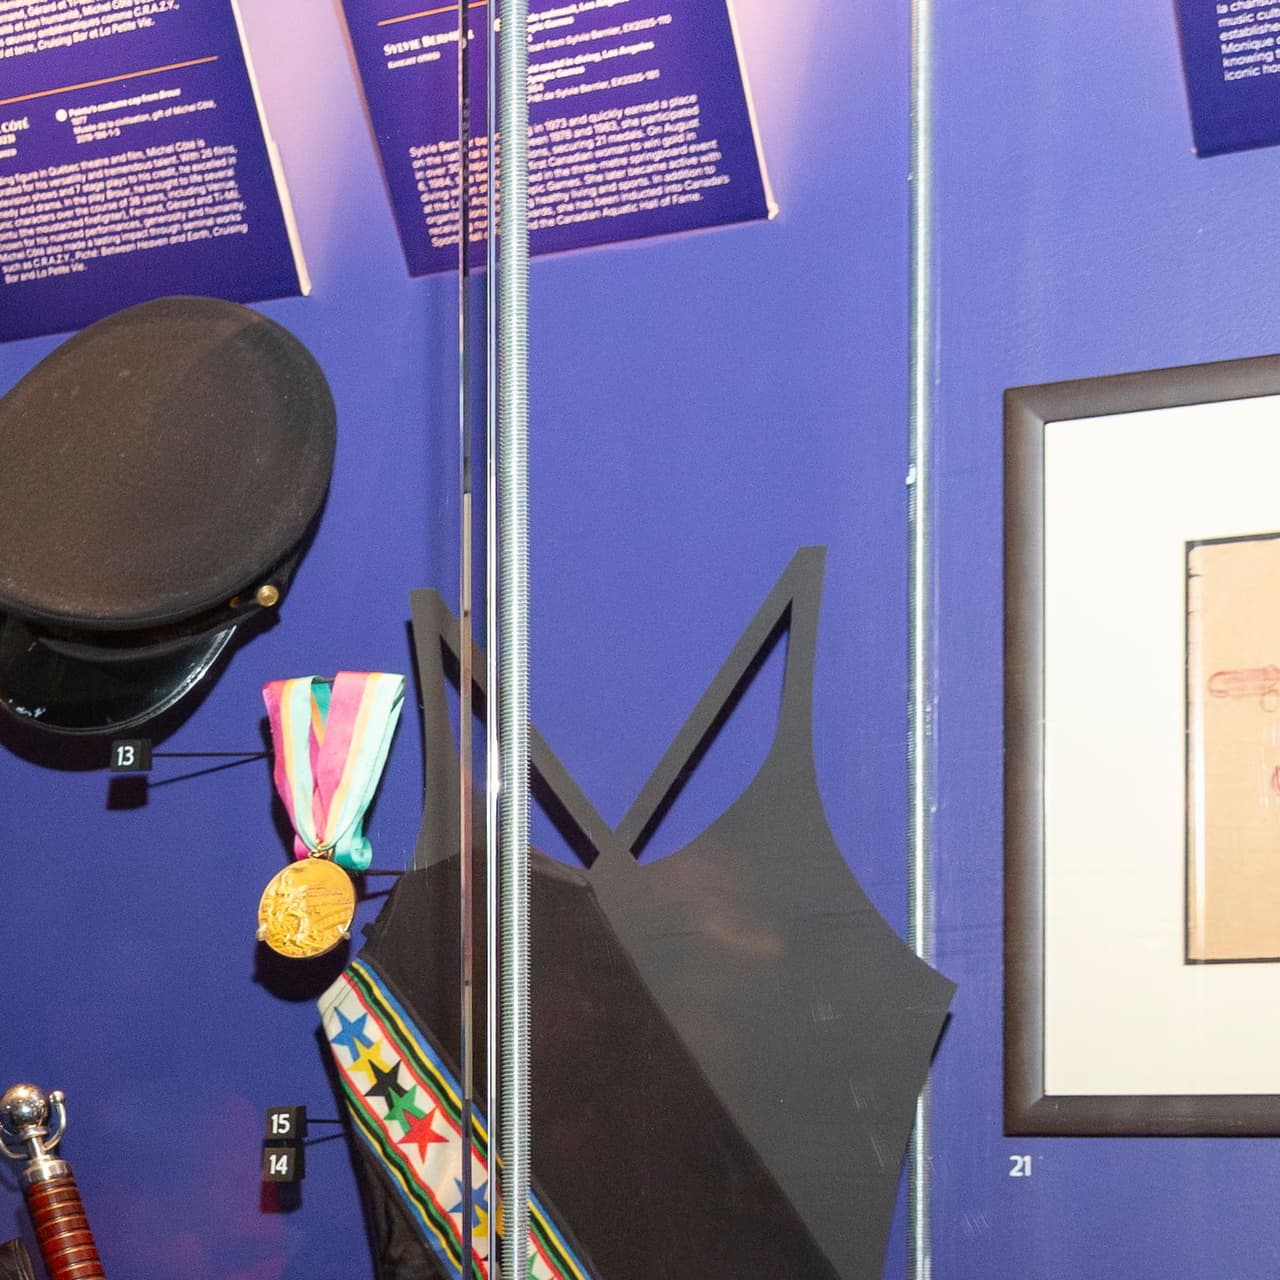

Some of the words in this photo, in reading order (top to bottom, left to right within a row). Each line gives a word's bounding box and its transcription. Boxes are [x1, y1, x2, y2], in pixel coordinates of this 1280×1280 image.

[1221, 37, 1274, 54] Monique
[1224, 66, 1261, 80] iconic
[117, 746, 134, 766] 13
[271, 1114, 290, 1134] 15
[269, 1154, 288, 1174] 14
[1009, 1155, 1032, 1176] 21
